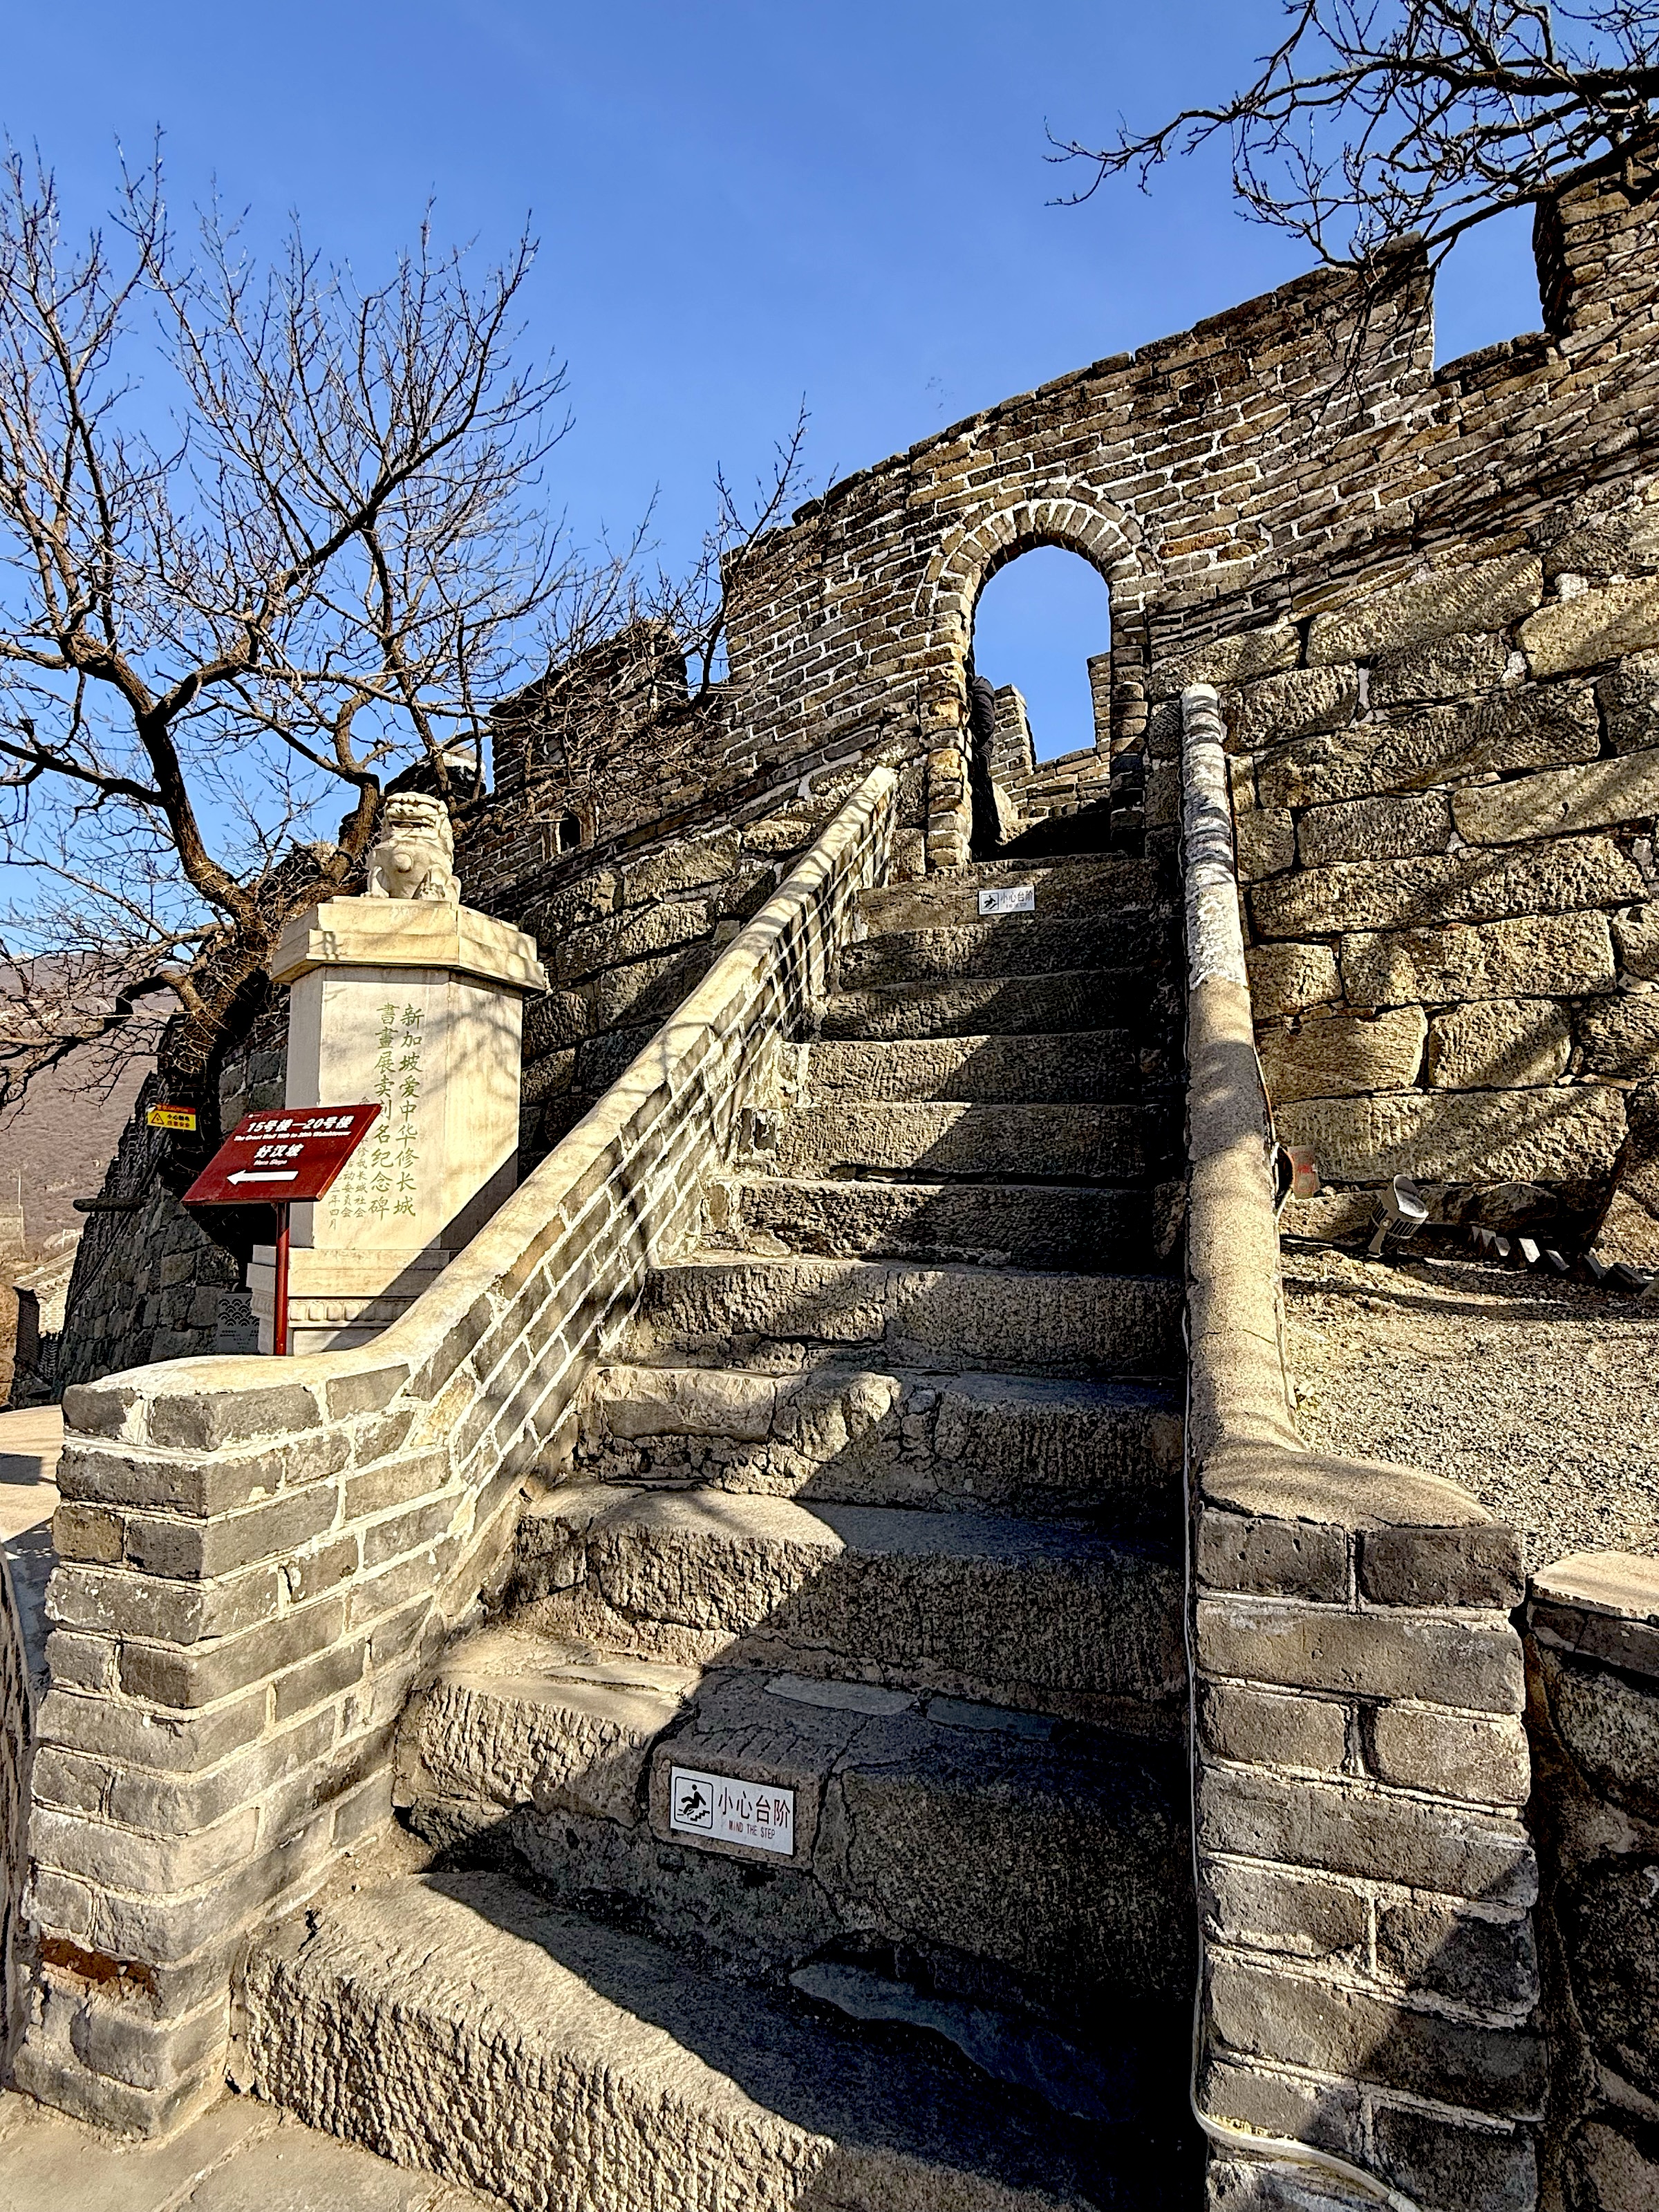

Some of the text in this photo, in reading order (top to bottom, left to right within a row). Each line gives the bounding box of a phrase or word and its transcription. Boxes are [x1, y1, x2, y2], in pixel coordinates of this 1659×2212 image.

[1000, 890, 1033, 903] 小心台阶
[393, 1002, 424, 1218] 新加坡爱中华修长城
[718, 1787, 790, 1828] 小心台阶
[729, 1820, 776, 1839] MIND THE STEP
